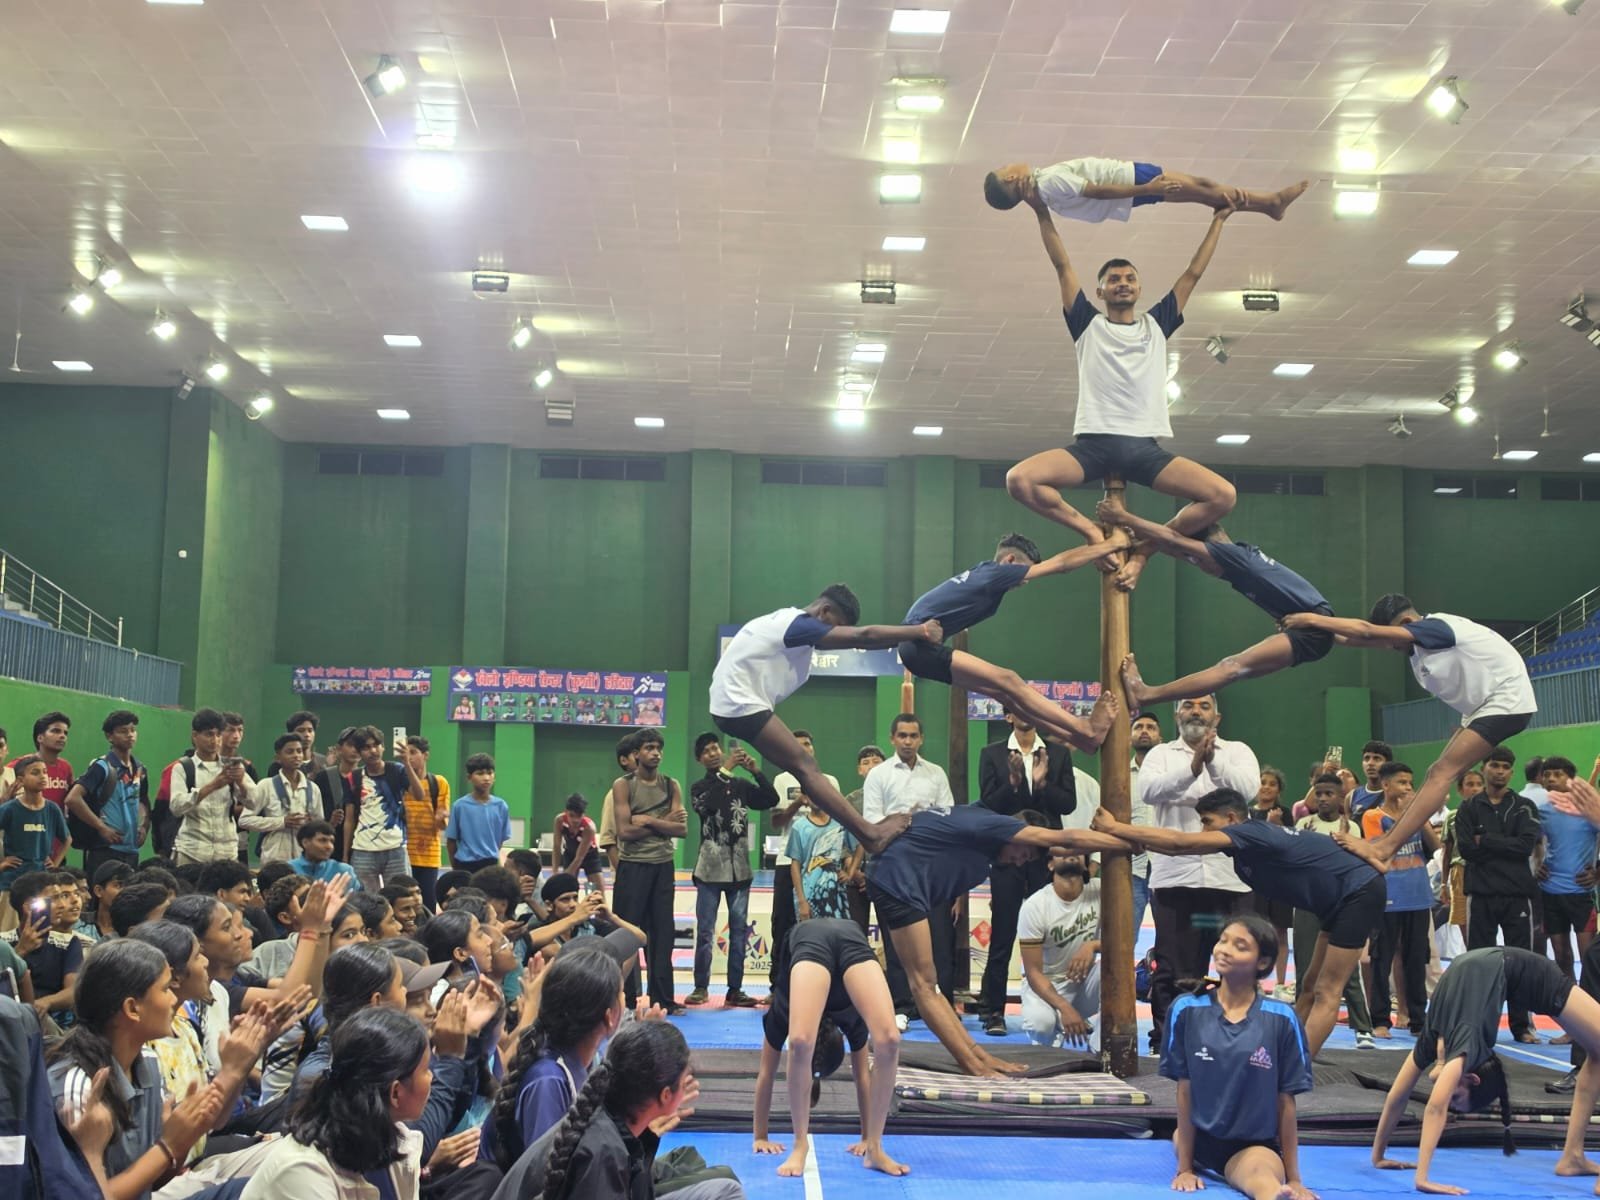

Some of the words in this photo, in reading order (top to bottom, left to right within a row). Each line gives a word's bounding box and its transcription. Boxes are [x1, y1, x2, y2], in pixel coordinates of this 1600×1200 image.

[475, 669, 500, 687] खेलो
[1050, 925, 1078, 942] New
[1074, 905, 1098, 929] York
